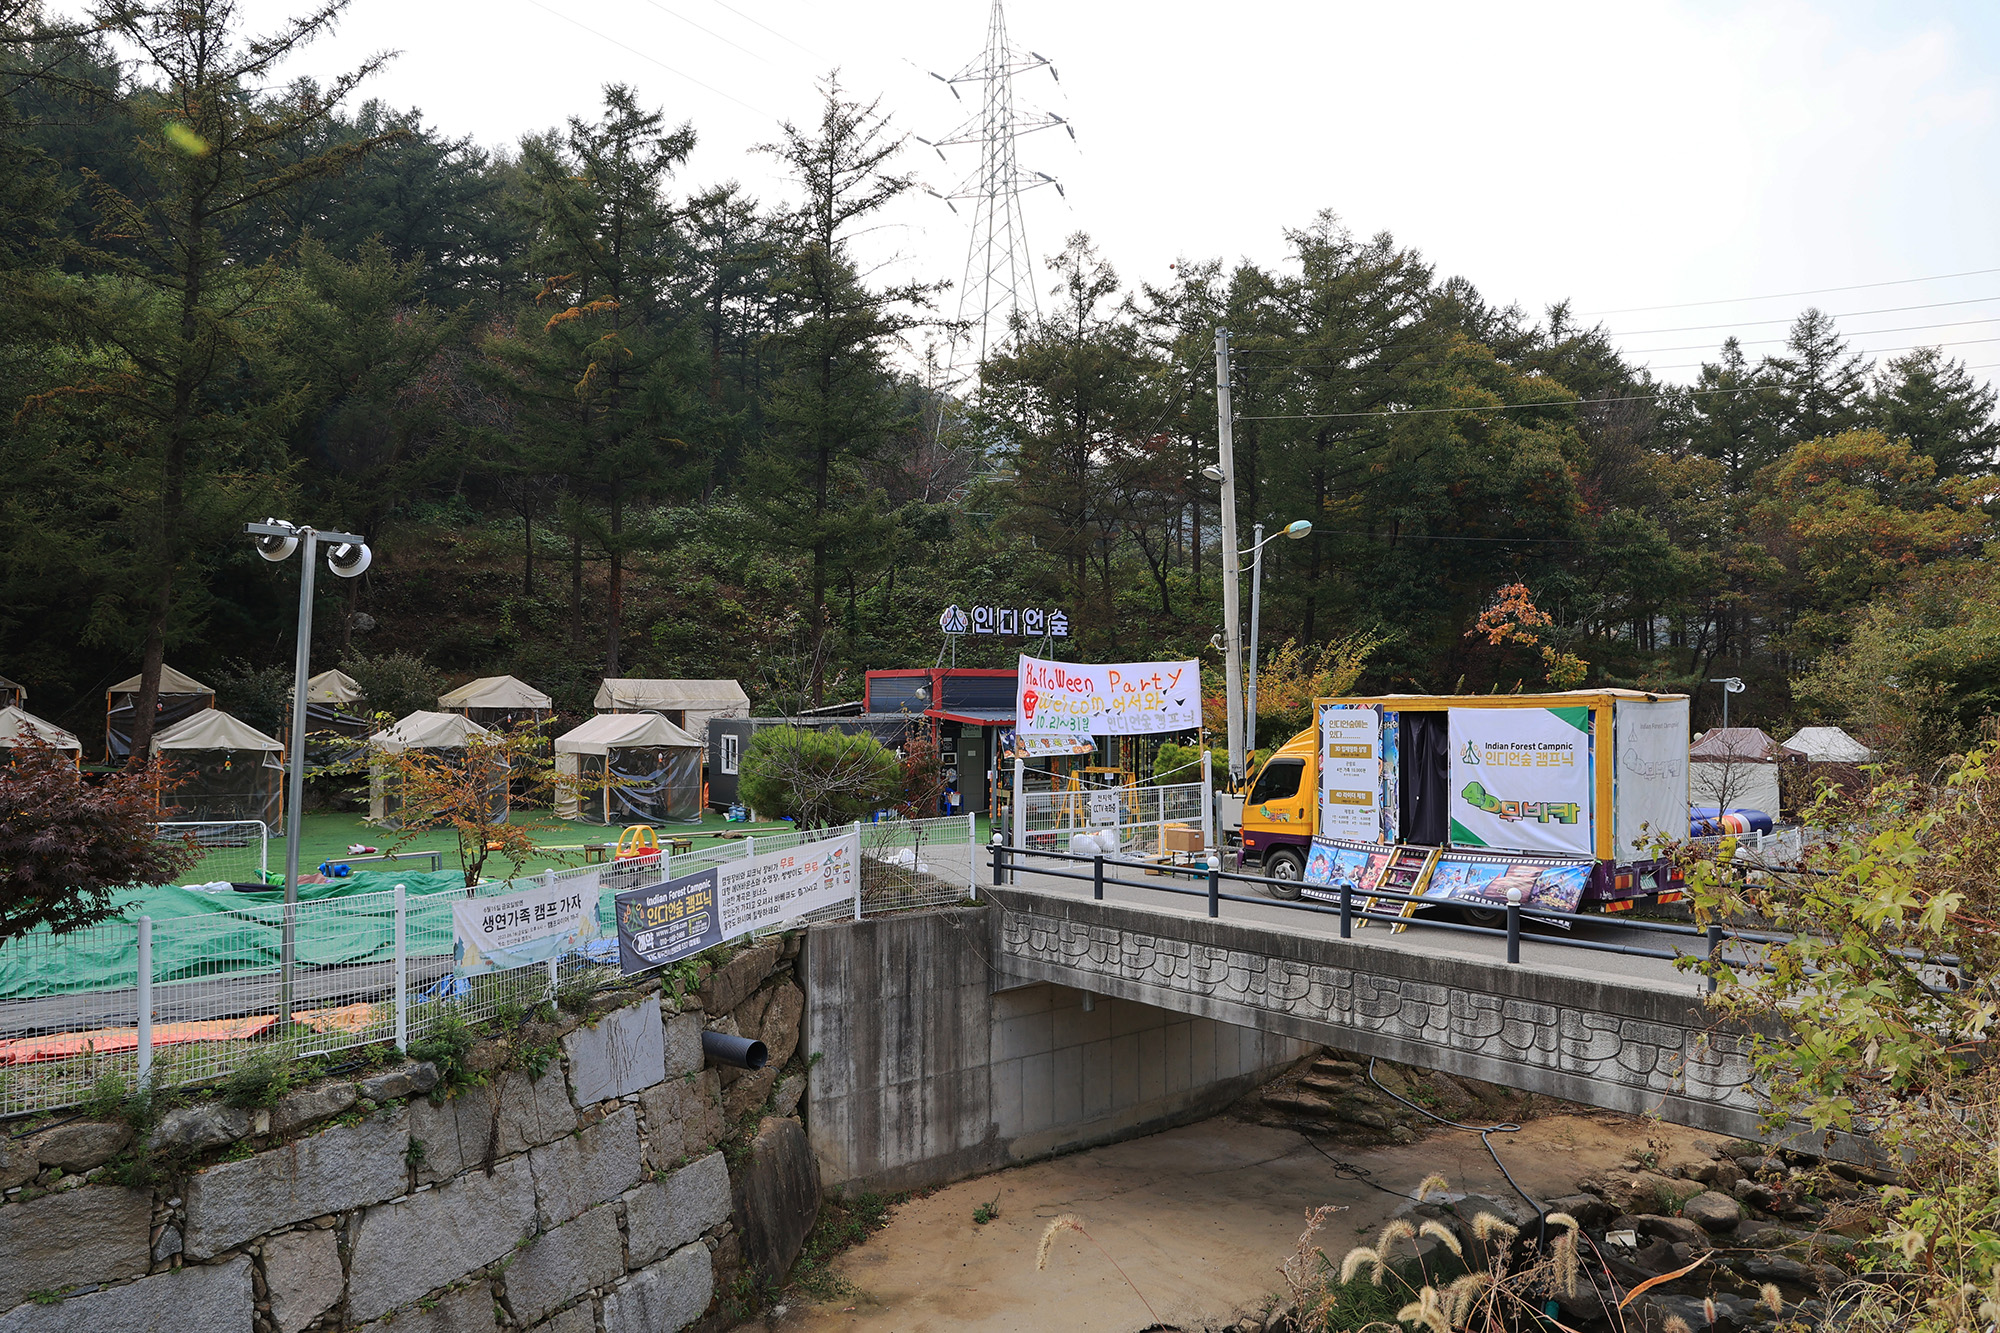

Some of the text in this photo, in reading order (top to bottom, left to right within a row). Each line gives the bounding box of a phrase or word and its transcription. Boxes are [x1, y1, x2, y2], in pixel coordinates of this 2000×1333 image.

[971, 605, 1069, 637] 인디언숲
[1108, 668, 1182, 693] Party
[1112, 692, 1165, 713] 어서와
[1036, 715, 1090, 733] 10.21~31일
[1329, 720, 1368, 729] 인디언숲에는
[1485, 742, 1573, 752] Indian Forest Campnic
[1485, 752, 1574, 767] 인디언숲 캠프닉
[1093, 804, 1104, 813] CCTV
[1461, 781, 1581, 824] 4D무비카
[747, 867, 762, 878] 피크닉
[763, 863, 778, 874] 장비가
[780, 856, 794, 869] 무료
[804, 861, 818, 874] 무료
[646, 878, 711, 906] Indian Forest Campnic
[736, 891, 751, 902] 계곡은
[752, 887, 767, 898] 보너스
[741, 901, 755, 911] 가지고
[757, 896, 773, 907] 오셔서
[774, 890, 796, 902] 바베큐도
[482, 893, 581, 933] 생연가족 캠프 가자
[647, 899, 684, 927] 인디언숲
[685, 889, 712, 914] 캠프닉
